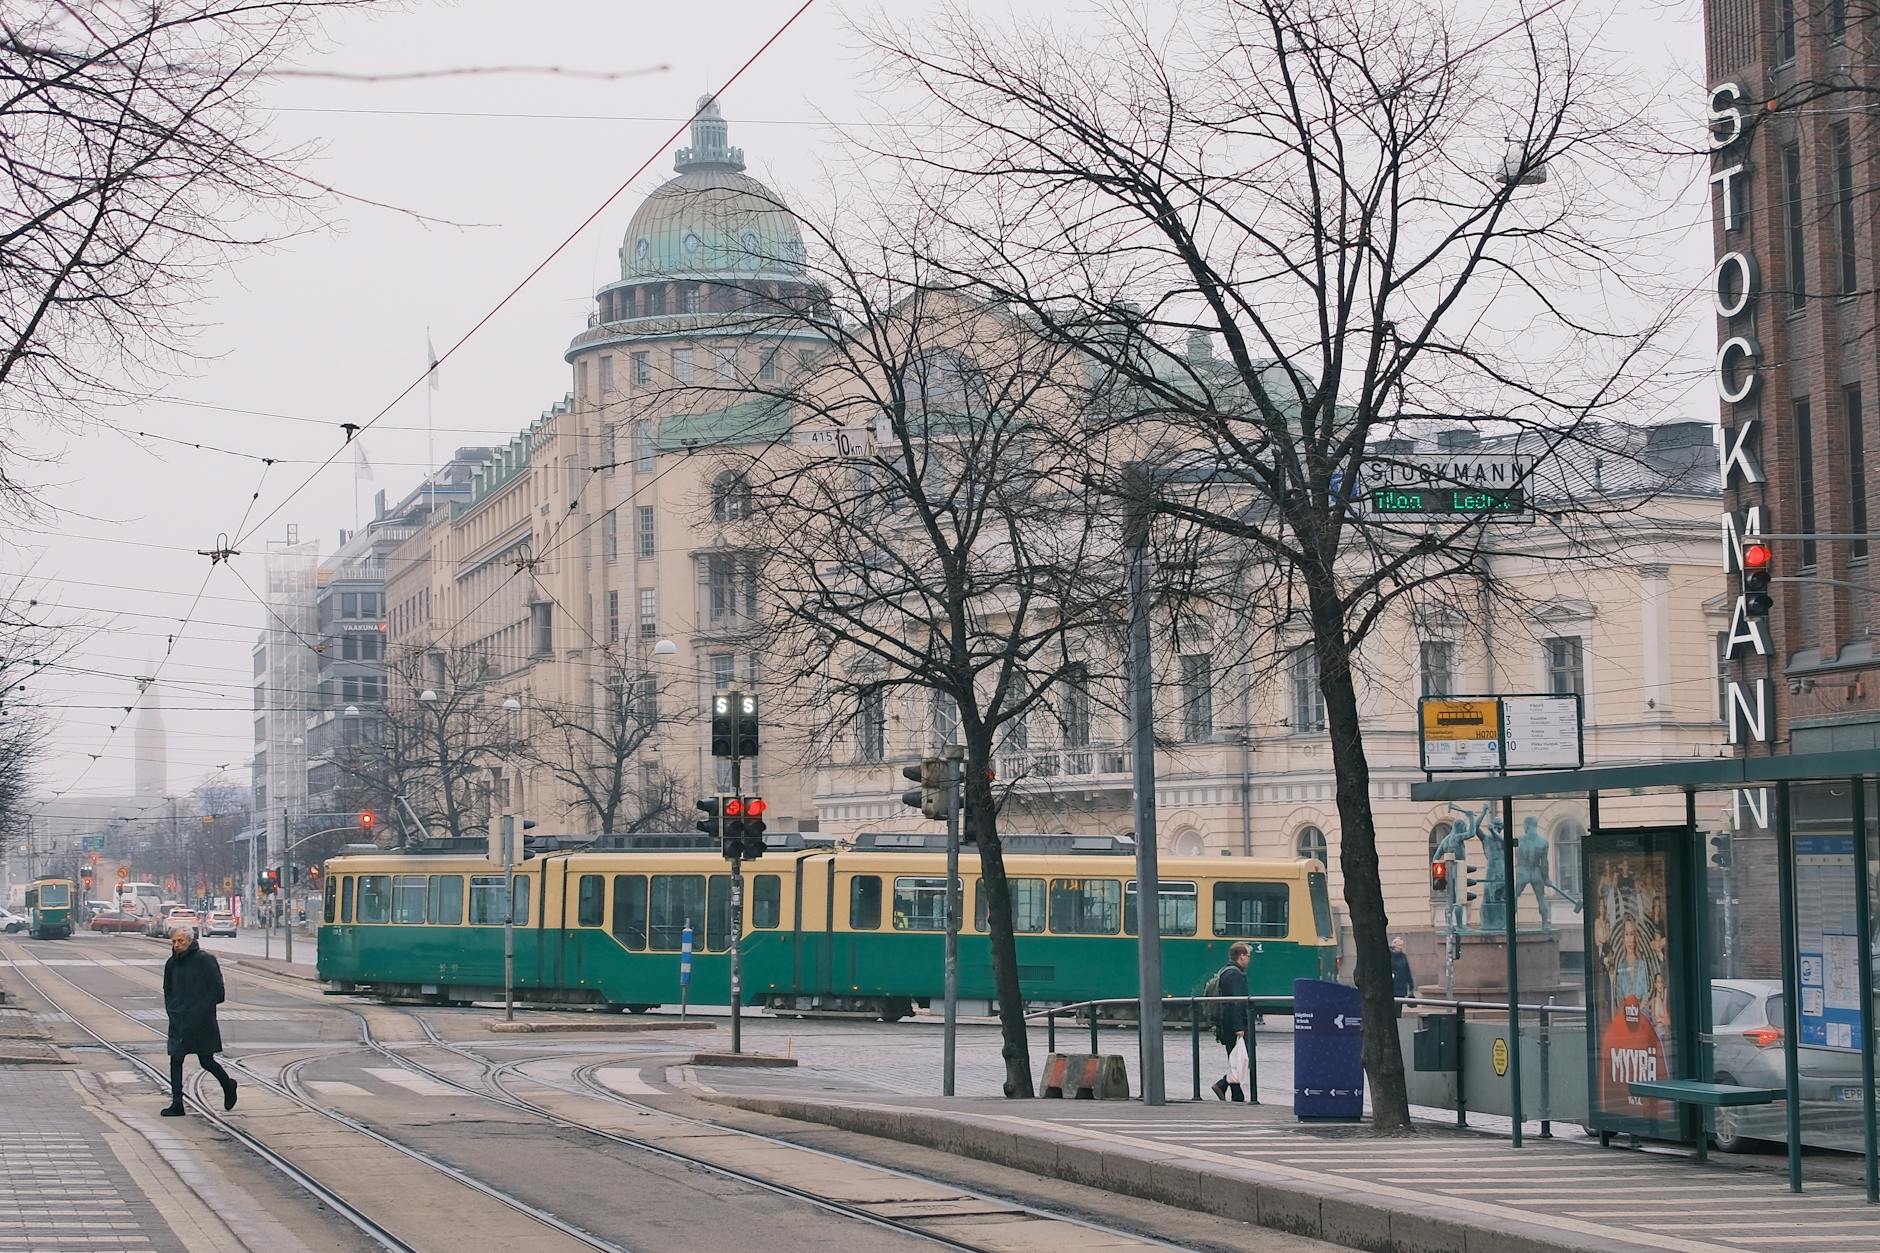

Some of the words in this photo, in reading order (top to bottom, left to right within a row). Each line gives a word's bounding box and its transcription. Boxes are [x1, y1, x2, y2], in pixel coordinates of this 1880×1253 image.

[812, 432, 832, 442] 415
[1506, 715, 1511, 725] 3
[1506, 728, 1512, 738] 6
[1506, 741, 1516, 751] 10
[1426, 755, 1430, 765] 1
[1611, 1047, 1657, 1083] MYYRÄ
